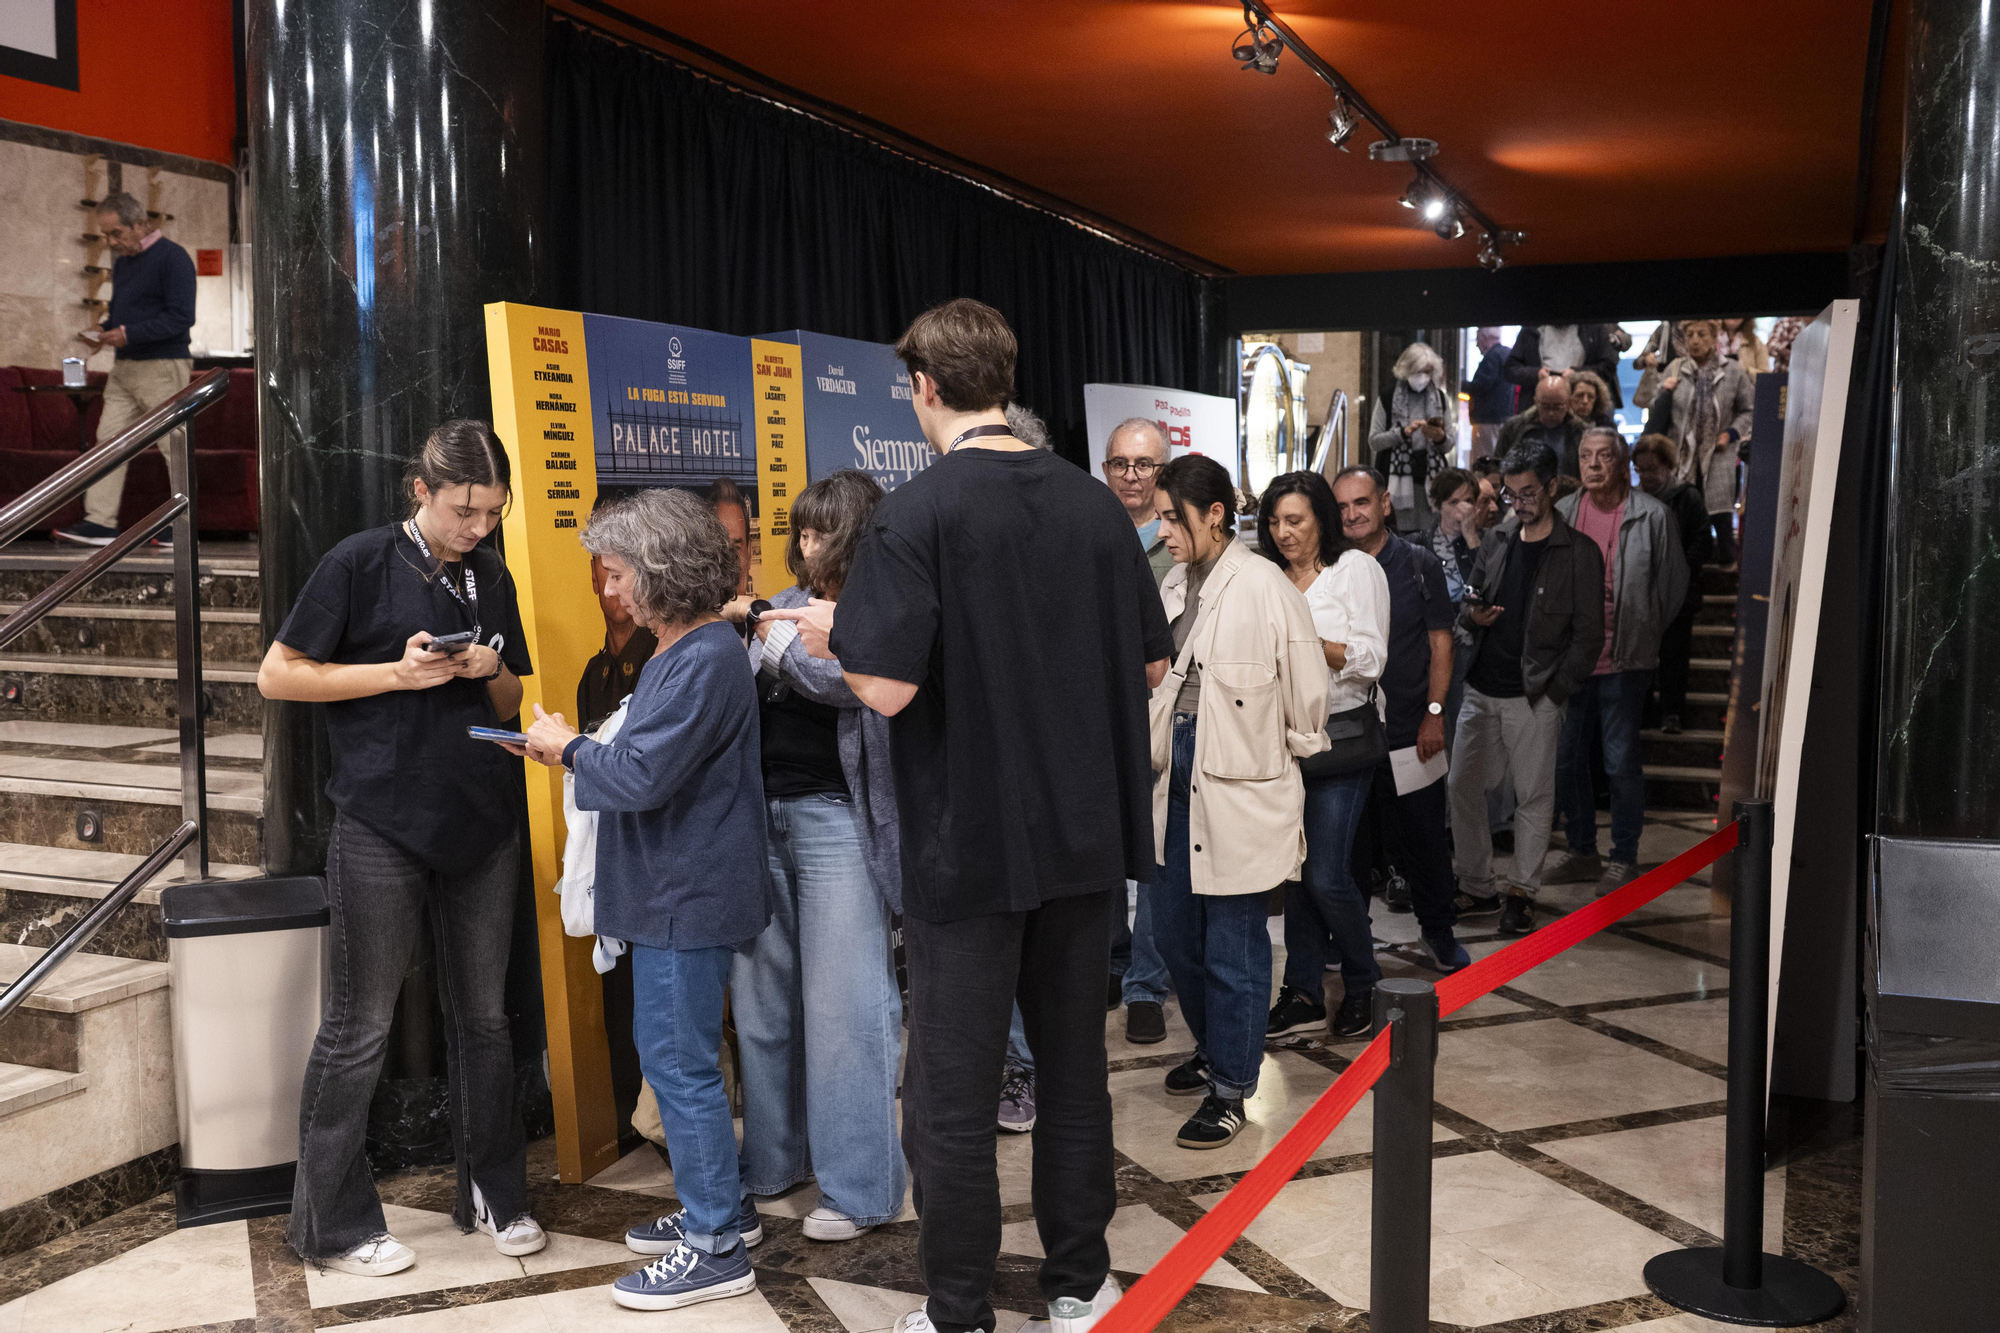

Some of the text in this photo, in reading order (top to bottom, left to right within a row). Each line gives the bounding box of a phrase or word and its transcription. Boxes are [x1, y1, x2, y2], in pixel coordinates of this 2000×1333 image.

[538, 326, 561, 338] MARIO
[533, 337, 569, 355] CASAS
[667, 359, 686, 371] SSIFF
[764, 355, 784, 365] ALBERTO
[546, 363, 560, 371] ASIER
[756, 363, 792, 379] SAN JUAN
[828, 364, 844, 377] David
[534, 370, 574, 384] ETXEANDIA
[816, 376, 857, 396] VERDAGUER
[549, 393, 563, 401] NORA
[628, 387, 727, 408] LA FUGA ESTÁ SERVIDA
[764, 391, 787, 402] LASARTE
[536, 399, 577, 413] HERNÁNDEZ
[1155, 399, 1191, 417] Paz Padilla
[550, 422, 567, 430] ELVIRA
[767, 416, 787, 426] UGARTE
[543, 428, 575, 441] MÍNGUEZ
[613, 423, 741, 457] PALACE HOTEL
[771, 438, 784, 449] PÁEZ
[551, 451, 571, 459] CARMEN
[852, 425, 937, 481] Siempre
[545, 459, 578, 470] BALAGUÉ
[547, 489, 580, 500] SERRANO
[772, 489, 787, 497] ORTIZ
[556, 510, 575, 518] FERRAN
[554, 518, 578, 529] GADEA
[465, 568, 477, 601] STAFF
